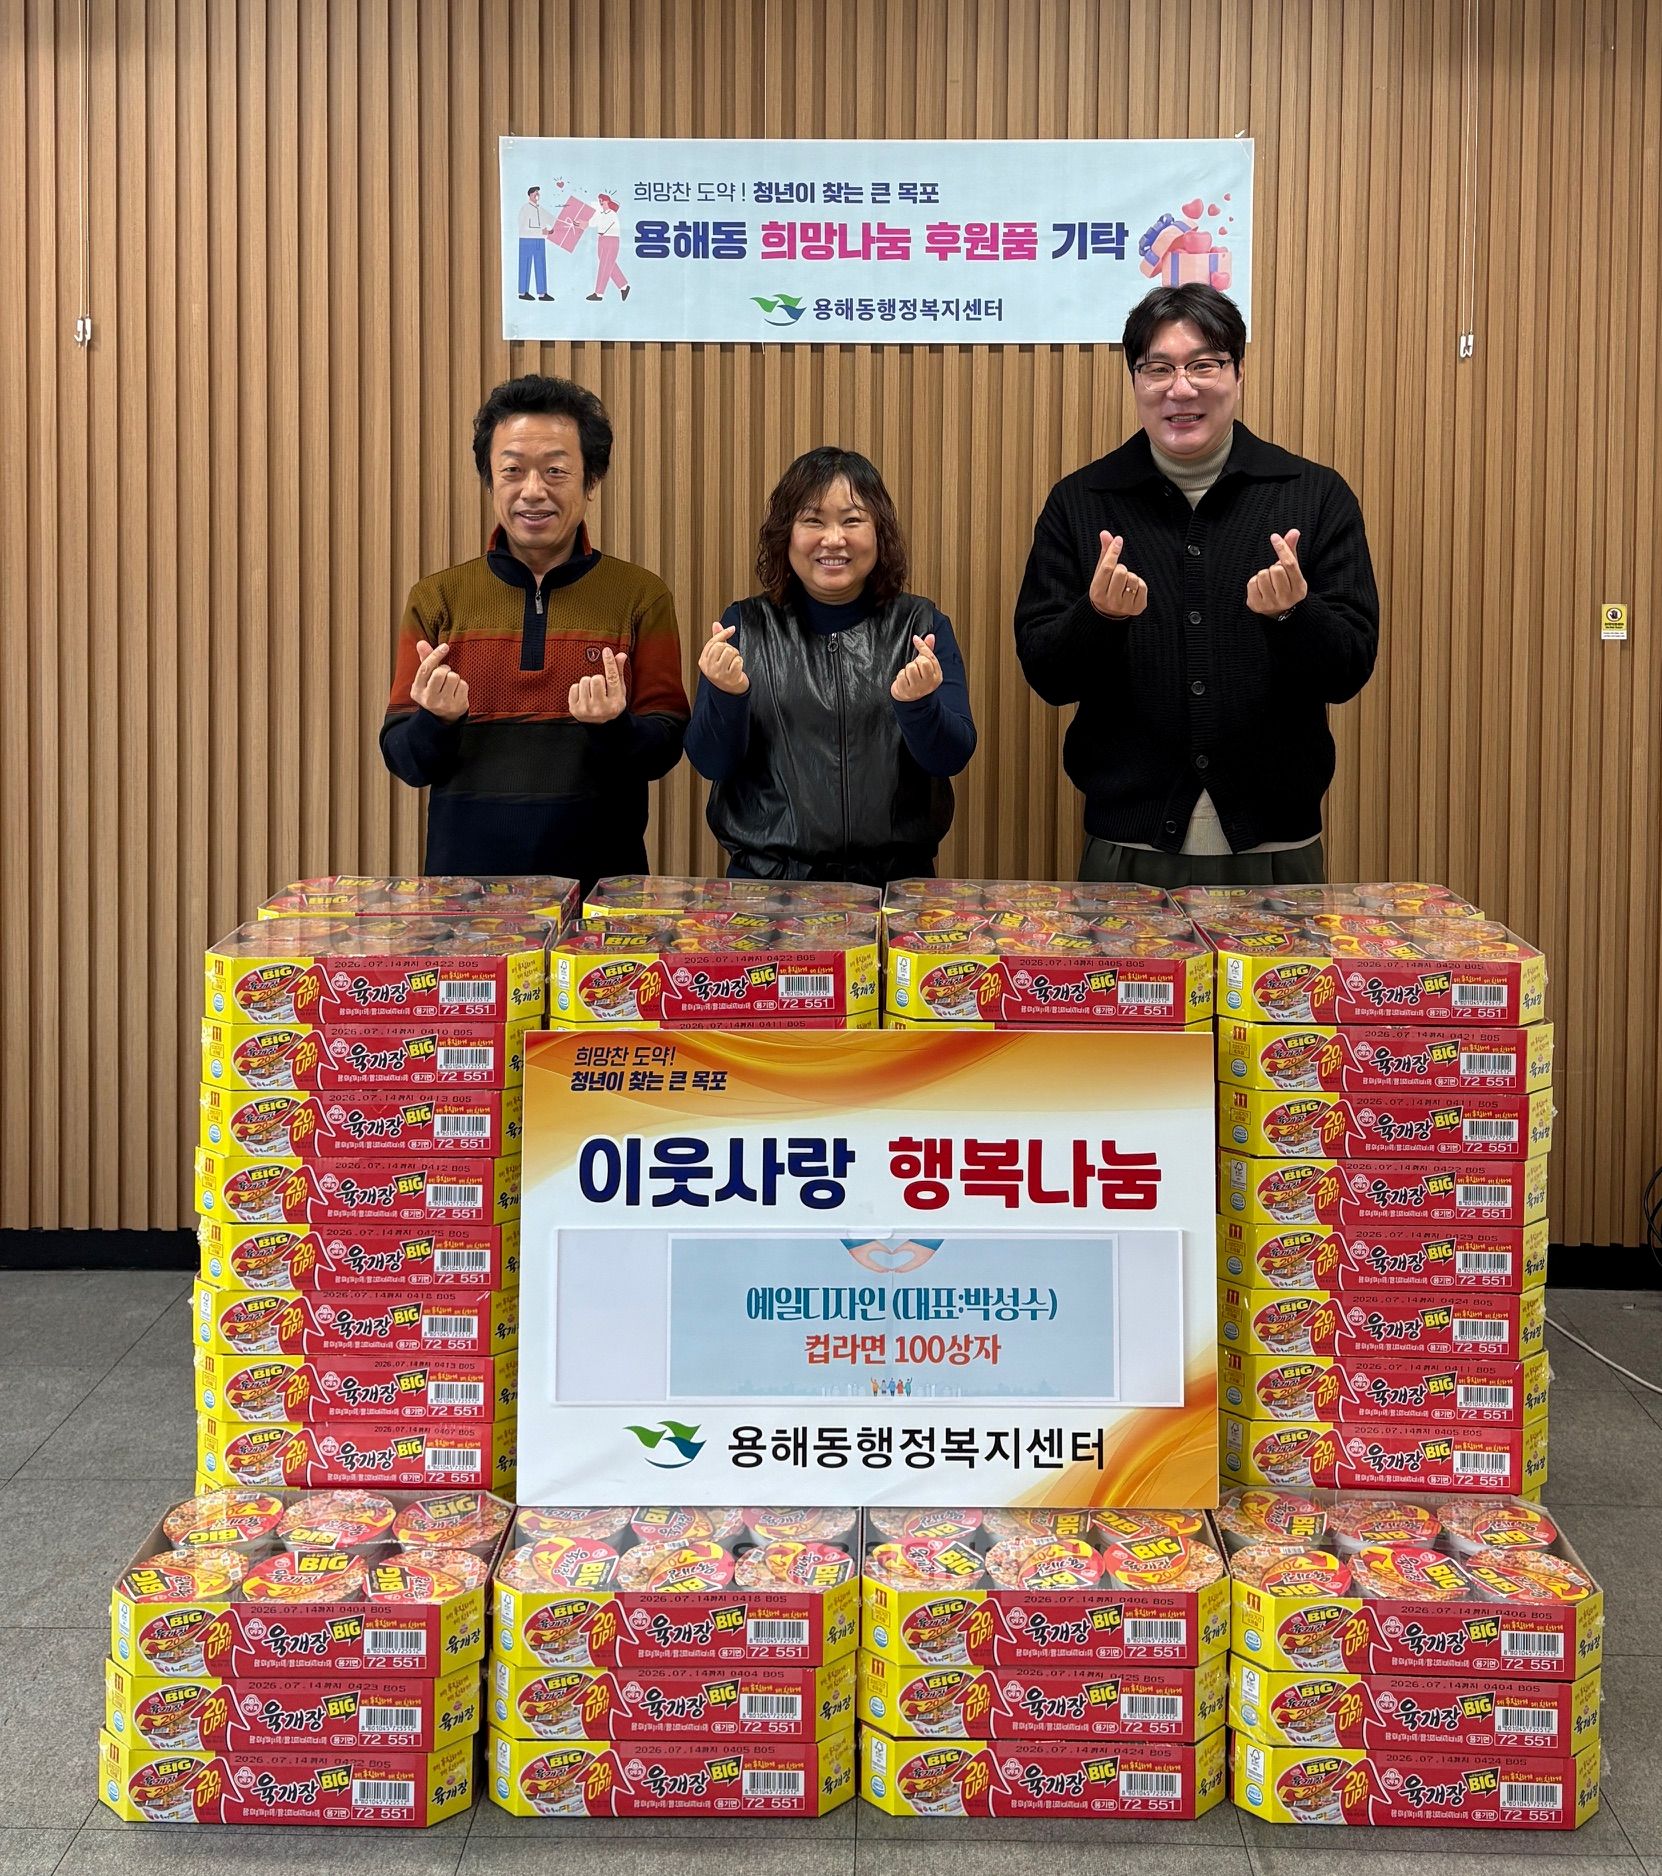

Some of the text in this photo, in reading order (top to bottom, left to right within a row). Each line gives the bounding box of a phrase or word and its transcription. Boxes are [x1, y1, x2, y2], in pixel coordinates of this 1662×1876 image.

[634, 181, 692, 202] 희망찬
[753, 181, 815, 204] 청년이
[822, 181, 864, 204] 찾는
[870, 181, 891, 204] 큰
[897, 181, 940, 204] 목포
[634, 220, 1129, 261] 용해동 희망나눔 후원품 기탁
[812, 297, 1003, 322] 용해동행정복지센터
[923, 931, 968, 945] BIG
[348, 977, 436, 1005] 육개장 BIG
[690, 967, 776, 1000] 육개장 BIG
[1029, 974, 1116, 1003] 육개장 BIG
[1364, 976, 1450, 1005] 육개장 BIG
[442, 1006, 490, 1014] 72 551
[783, 999, 829, 1008] 72 551
[1120, 1006, 1168, 1016] 72 551
[1455, 1008, 1502, 1018] 72 551
[346, 1044, 434, 1072] 육개장 BIG
[574, 1046, 676, 1066] 희망찬 도약!
[1372, 1046, 1458, 1074] 육개장 BIG
[570, 1070, 728, 1091] 청년이 찾는 큰 목포
[343, 1110, 431, 1138] 육개장 BIG
[1374, 1112, 1460, 1141] 육개장 BIG
[578, 1136, 1162, 1211] 이웃사랑 행복나눔
[335, 1179, 423, 1207] 육개장 BIG
[1368, 1178, 1454, 1207] 육개장 BIG
[343, 1245, 431, 1273] 육개장 BIG
[1366, 1244, 1452, 1273] 육개장 BIG
[436, 1274, 485, 1284] 72 551
[1459, 1276, 1506, 1285] 72 551
[746, 1287, 1058, 1321] 예일디자인 (대표:박성수)
[331, 1310, 419, 1338] 육개장 BIG
[1364, 1312, 1450, 1340] 육개장 BIG
[804, 1333, 1002, 1365] 컵라면 100상자
[337, 1377, 425, 1405] 육개장 BIG
[1368, 1378, 1454, 1406] 육개장 BIG
[335, 1443, 422, 1471] 육개장 BIG
[728, 1425, 1104, 1470] 용해동행정복지센터
[1364, 1444, 1450, 1471] 육개장 BIG
[1132, 1538, 1183, 1559] BIG
[298, 1554, 348, 1572] BIG
[263, 1624, 360, 1656] 육개장 BIG
[446, 1629, 480, 1654] 육개장
[648, 1612, 744, 1646] 육개장 BIG
[827, 1621, 855, 1645] 육개장
[1025, 1612, 1120, 1645] 육개장 BIG
[1400, 1623, 1497, 1655] 육개장 BIG
[367, 1658, 419, 1668] 72 551
[751, 1648, 802, 1657] 72 551
[1128, 1647, 1180, 1657] 72 551
[1504, 1659, 1558, 1670] 72 551
[258, 1701, 355, 1732] 육개장 BIG
[640, 1686, 737, 1720] 육개장 BIG
[1021, 1687, 1118, 1719] 육개장 BIG
[1394, 1699, 1491, 1730] 육개장 BIG
[439, 1706, 474, 1731] 육개장
[744, 1723, 795, 1732] 72 551
[1124, 1722, 1176, 1733] 72 551
[362, 1735, 414, 1744] 72 551
[1498, 1735, 1552, 1746] 72 551
[251, 1774, 348, 1805] 육개장 BIG
[433, 1780, 468, 1805] 육개장
[642, 1764, 739, 1797] 육개장 BIG
[1020, 1764, 1116, 1797] 육개장 BIG
[1400, 1775, 1496, 1807] 육개장 BIG
[355, 1809, 407, 1818] 72 551
[747, 1799, 798, 1808] 72 551
[1123, 1800, 1175, 1810] 72 551
[1504, 1810, 1556, 1821] 72 551
